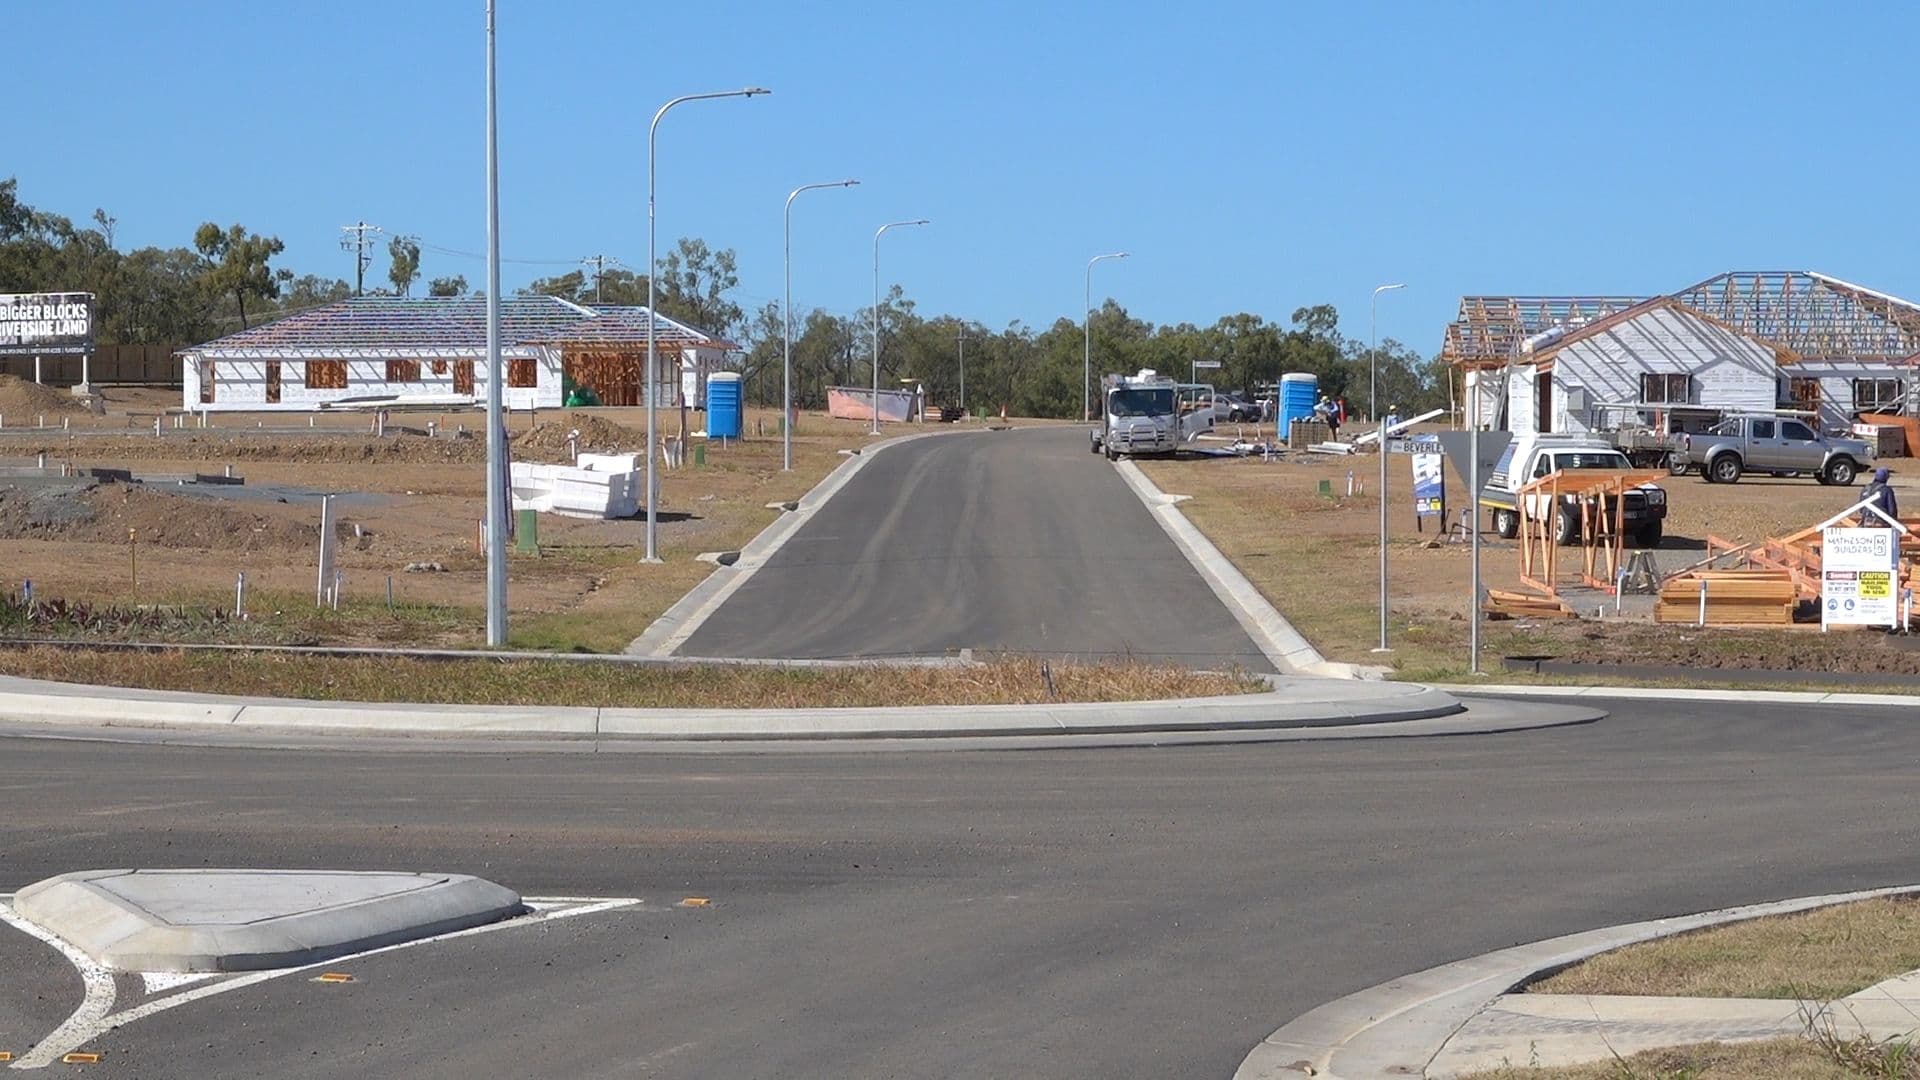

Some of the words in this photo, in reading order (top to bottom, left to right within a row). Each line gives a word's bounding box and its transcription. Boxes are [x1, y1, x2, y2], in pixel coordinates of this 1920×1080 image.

[0, 304, 41, 320] BIGGER
[43, 303, 88, 320] BLOCKS
[0, 320, 54, 336] IVERSIDE
[55, 319, 87, 336] LAND
[1828, 537, 1873, 545] MATHESON
[1833, 545, 1873, 554] BUILDERS
